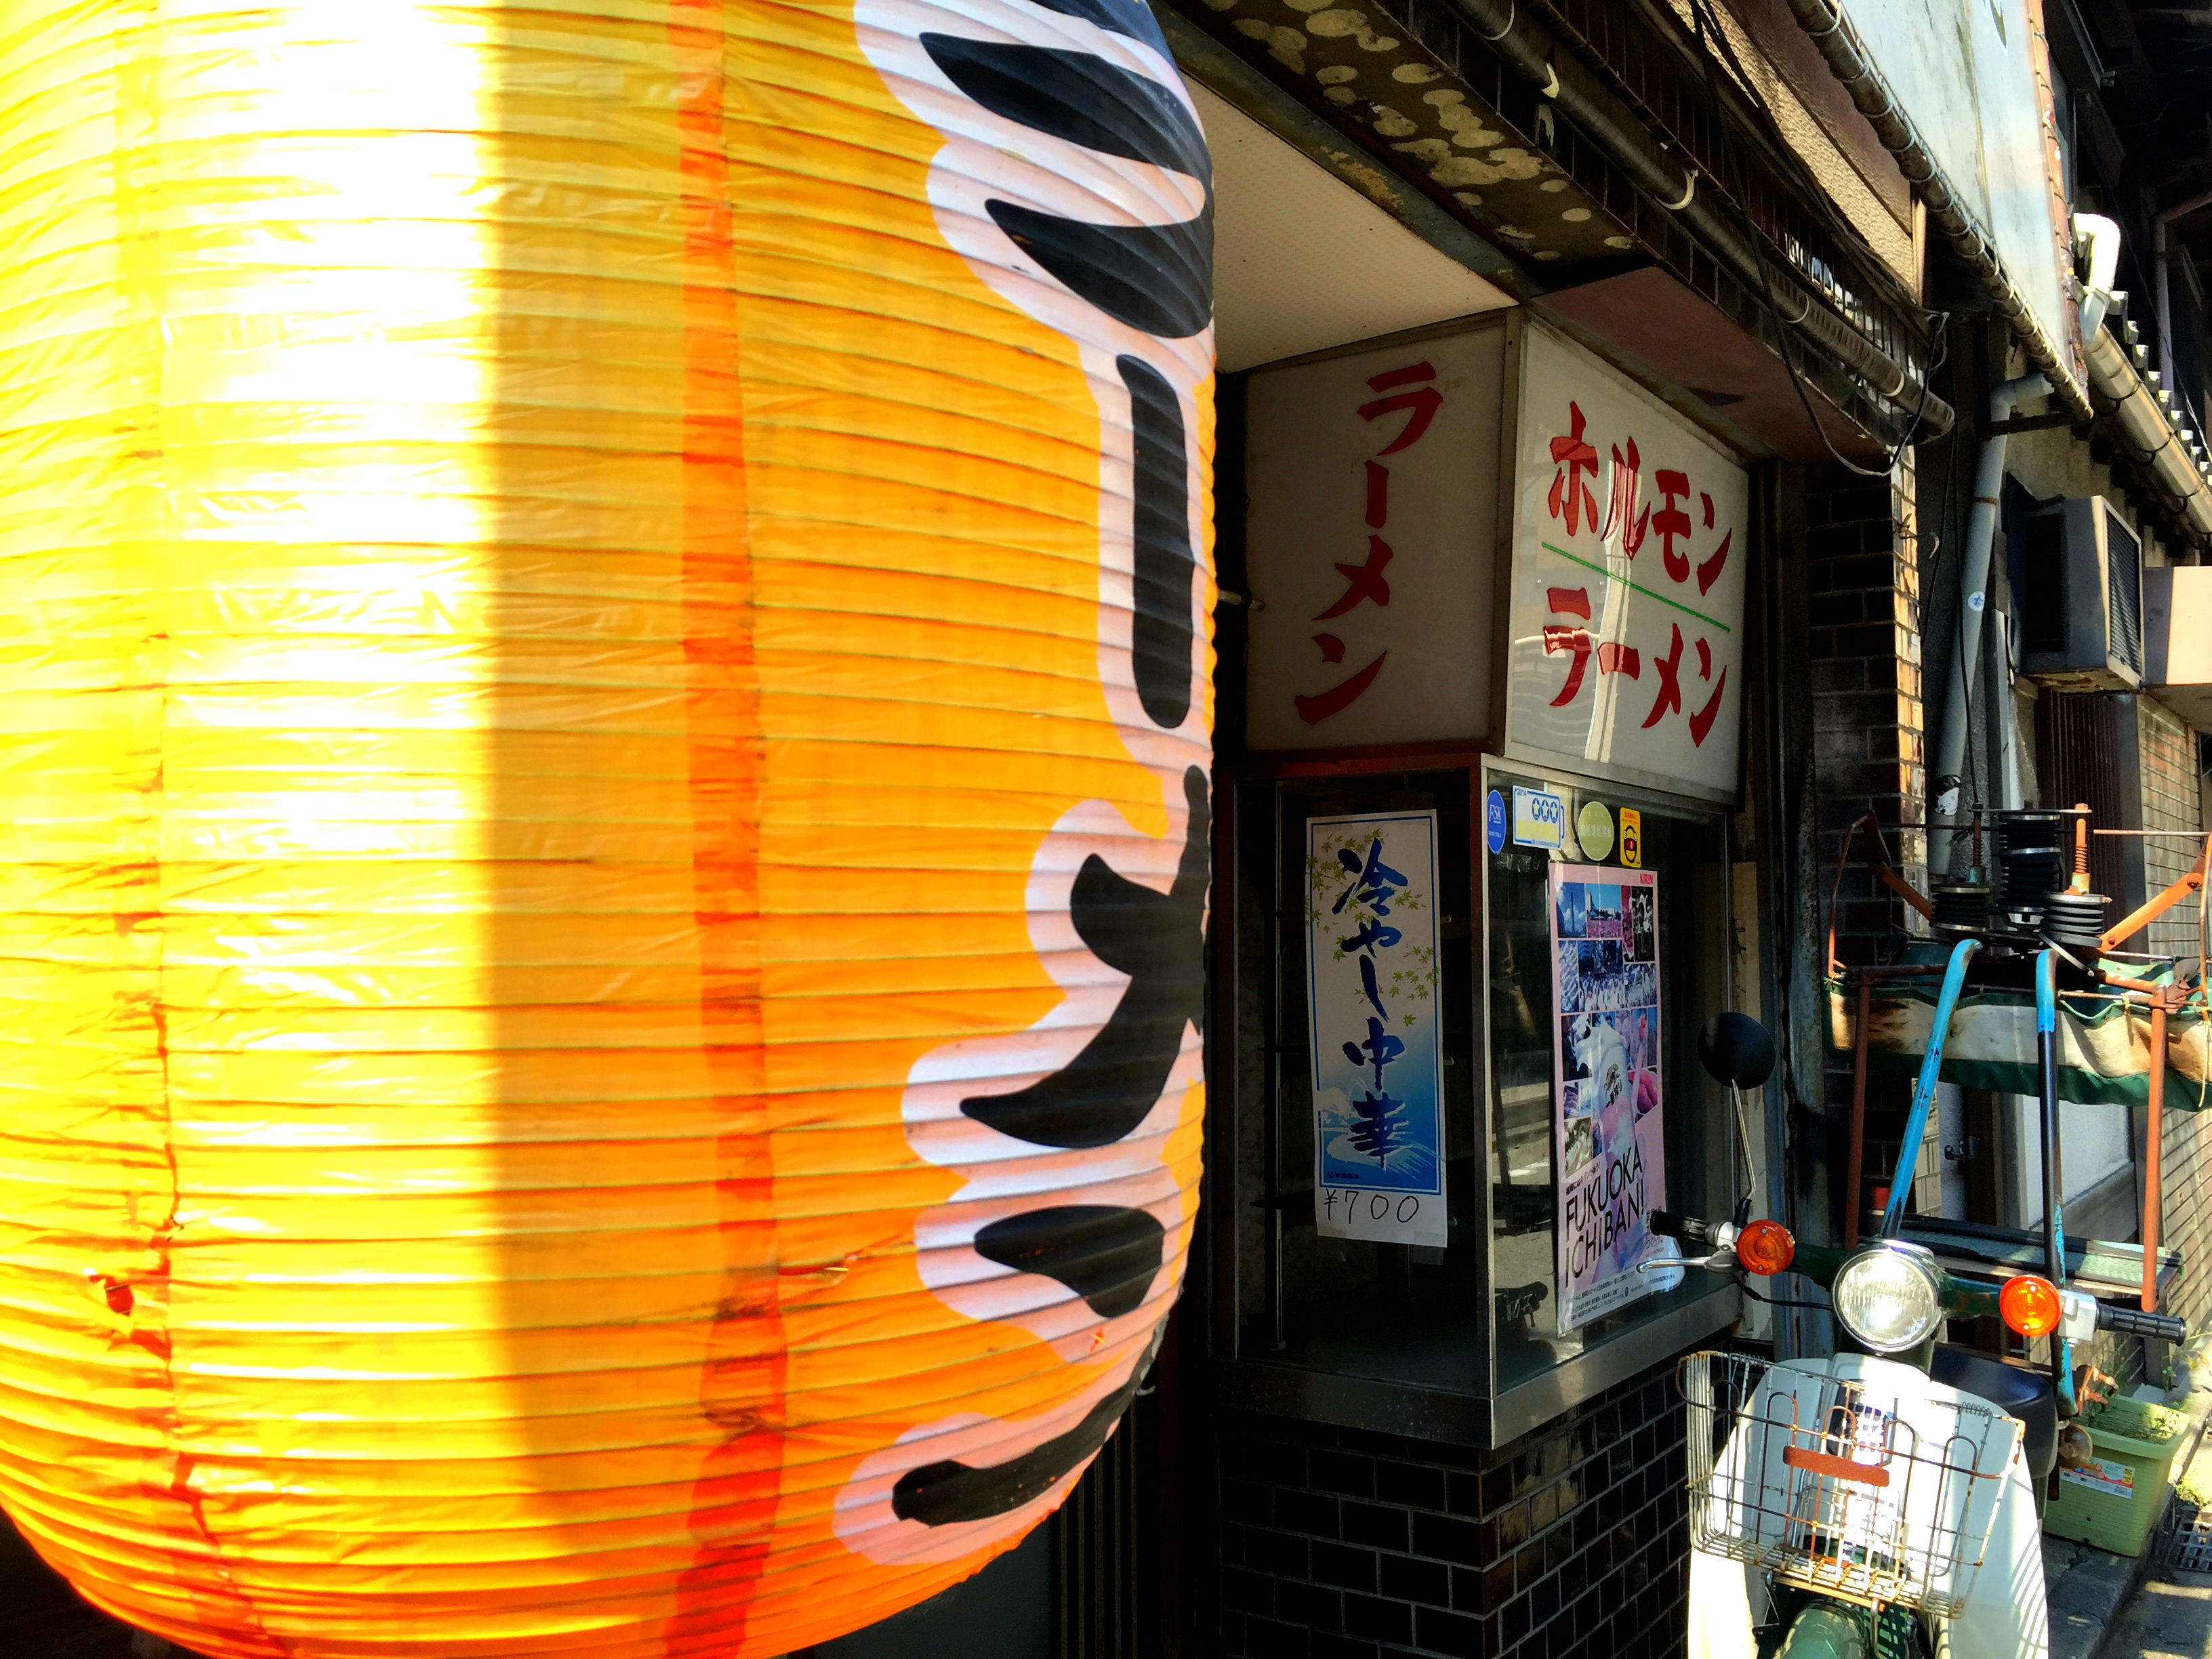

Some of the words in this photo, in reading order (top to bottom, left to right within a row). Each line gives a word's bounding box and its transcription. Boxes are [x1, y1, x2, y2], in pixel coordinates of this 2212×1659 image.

[1294, 361, 1443, 725] ラーメン
[1549, 401, 1732, 596] ホルモン
[1543, 587, 1727, 747] ラーメン
[1332, 837, 1412, 1170] 冷やし中華
[1324, 1189, 1419, 1224] ¥700
[1565, 1179, 1644, 1288] ICHIBAN!
[1566, 1140, 1643, 1242] FUKUOKA
